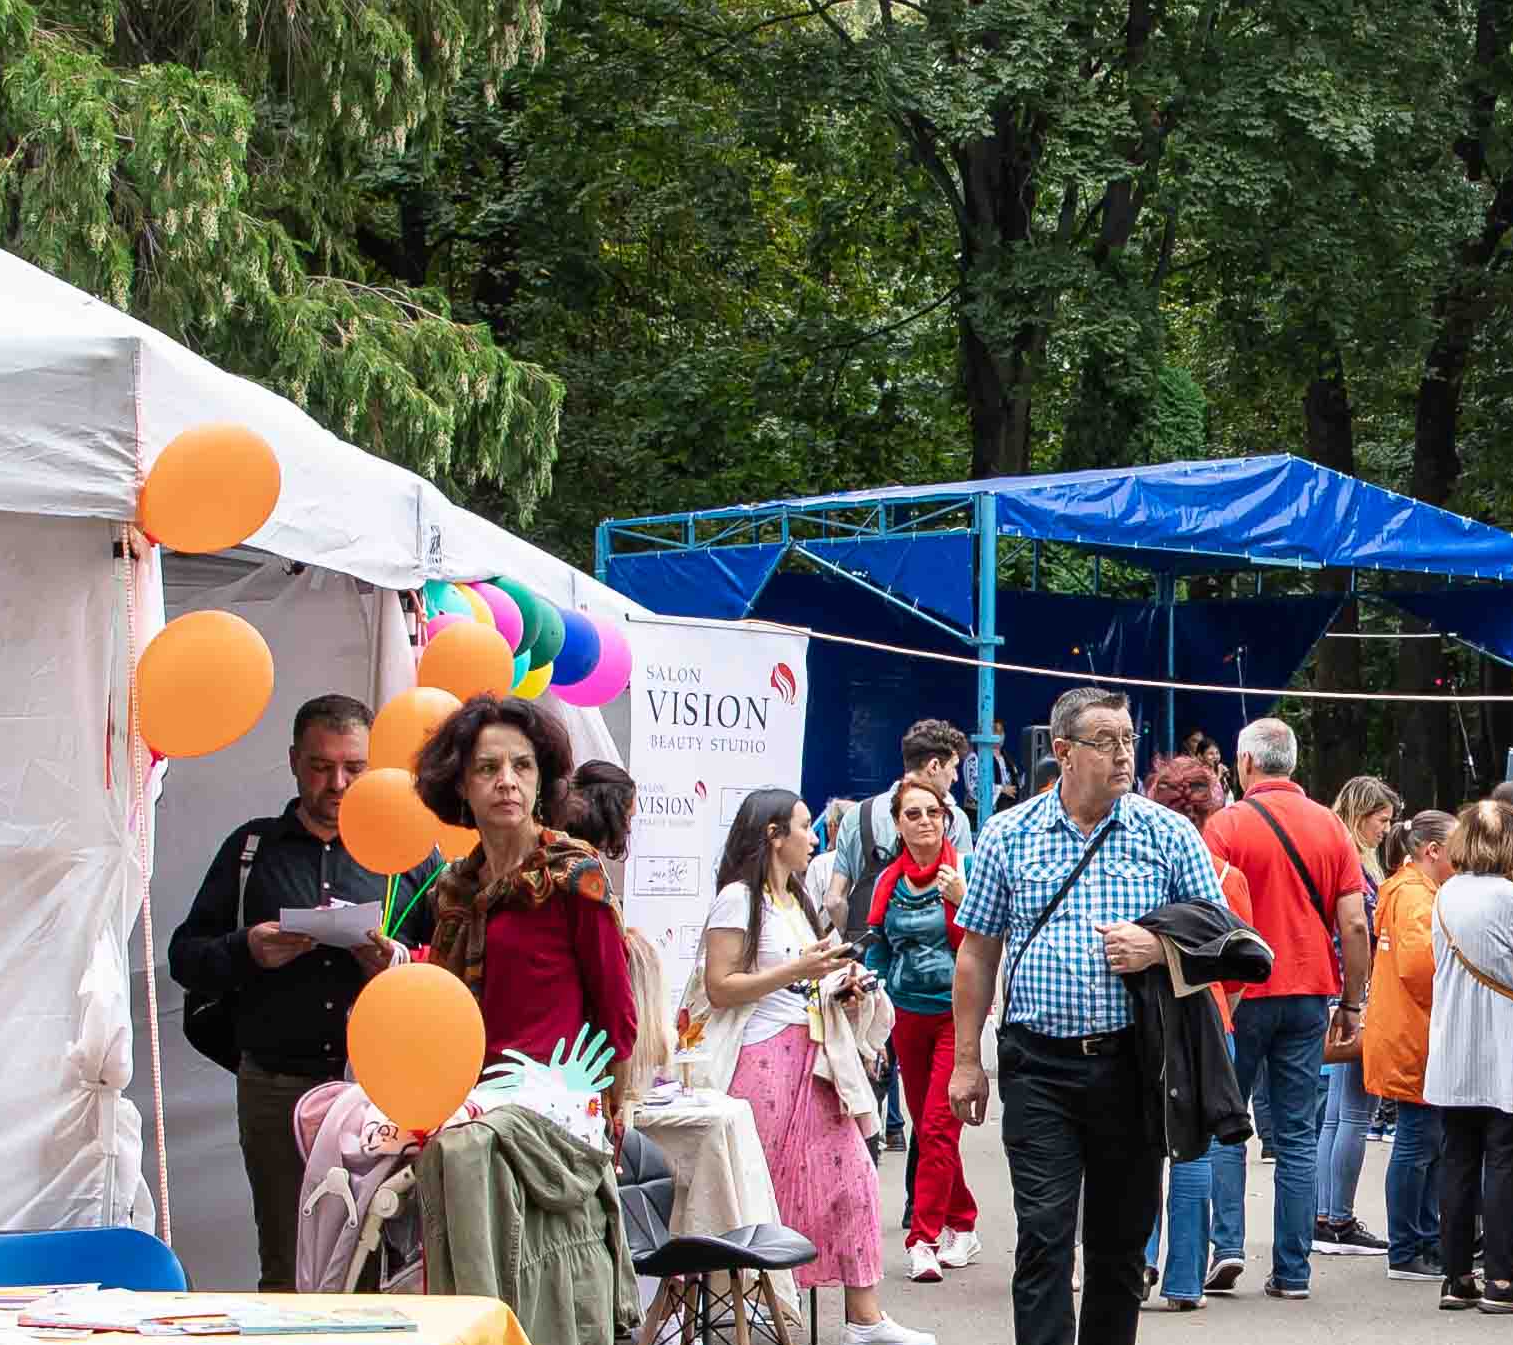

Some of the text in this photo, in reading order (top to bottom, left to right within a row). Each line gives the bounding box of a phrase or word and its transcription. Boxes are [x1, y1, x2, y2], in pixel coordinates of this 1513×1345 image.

[647, 664, 702, 684] SALON
[647, 689, 771, 731] VISION
[650, 734, 767, 753] BEAUTY STUDIO
[638, 796, 695, 815] VISION
